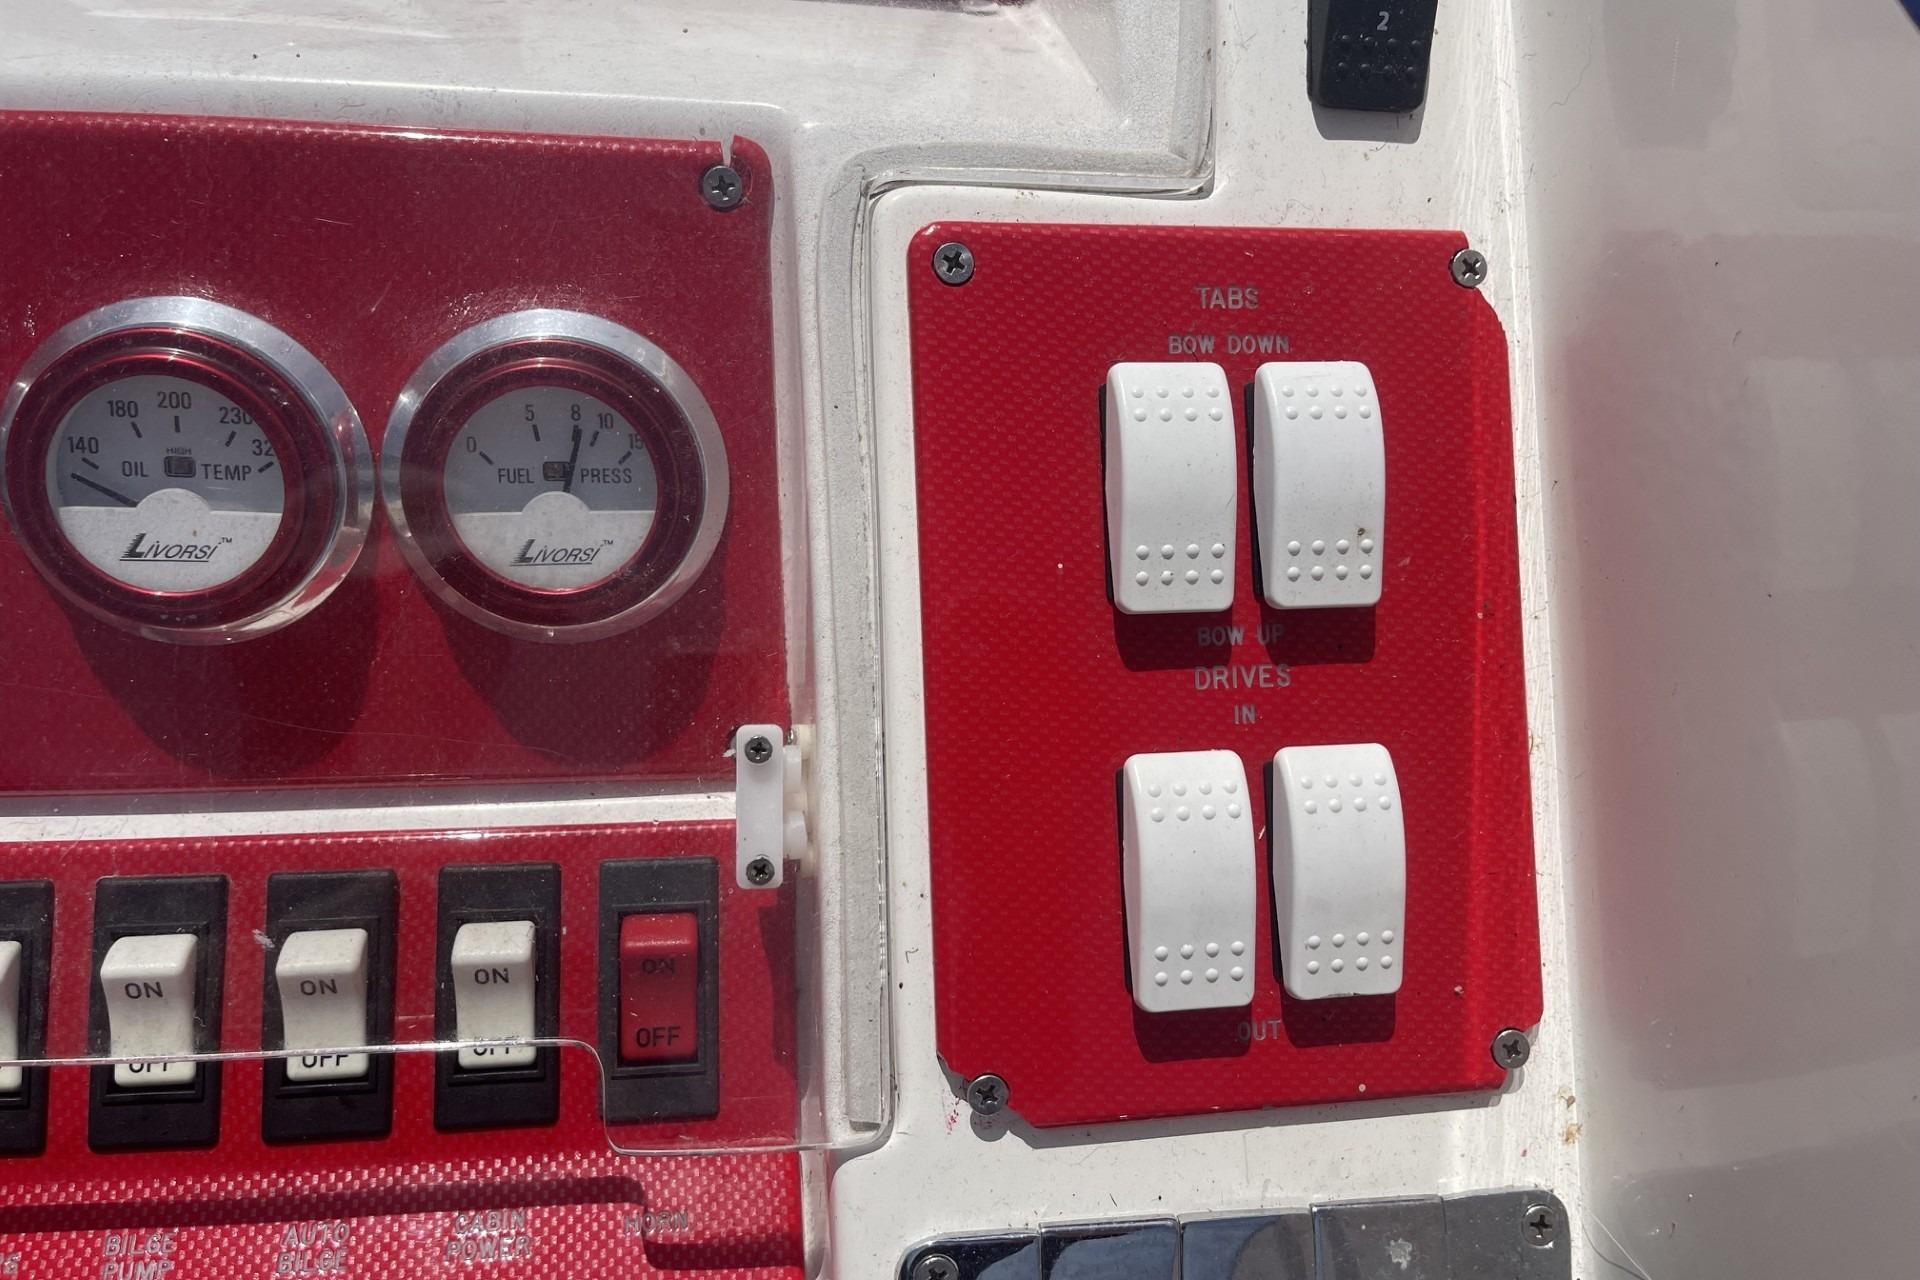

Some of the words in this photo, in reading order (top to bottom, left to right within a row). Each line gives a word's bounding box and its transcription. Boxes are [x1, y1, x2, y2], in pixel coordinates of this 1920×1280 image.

[1377, 11, 1390, 31] 2
[1195, 285, 1259, 309] TABS
[1168, 335, 1214, 354] BOW
[1227, 335, 1290, 354] DOWN
[157, 391, 192, 409] 200
[108, 401, 139, 419] 180
[525, 404, 535, 421] 5
[571, 404, 582, 421] 8
[597, 412, 614, 430] 10
[68, 436, 99, 455] 140
[166, 447, 192, 455] HIGH
[252, 438, 275, 457] 32
[466, 436, 477, 453] 0
[628, 433, 643, 450] 15
[122, 461, 149, 478] OIL
[201, 464, 252, 481] TEMP
[498, 468, 535, 484] FUEL
[580, 468, 632, 484] PRESS
[1198, 626, 1244, 645] BOW
[1256, 624, 1284, 645] UP
[1195, 664, 1291, 690] DRIVES
[1233, 704, 1256, 725] IN
[642, 958, 675, 974] ON
[474, 967, 510, 985] ON
[125, 981, 164, 999] ON
[301, 979, 338, 996] ON
[636, 1026, 681, 1048] OFF
[1238, 1019, 1281, 1041] OUT
[454, 1209, 526, 1235] CABIN
[624, 1208, 689, 1234] HORN
[282, 1222, 350, 1246] AUTO
[105, 1232, 177, 1256] BILGE
[445, 1234, 530, 1261] POWER
[102, 1259, 173, 1280] PUMP
[275, 1247, 348, 1274] BILGE
